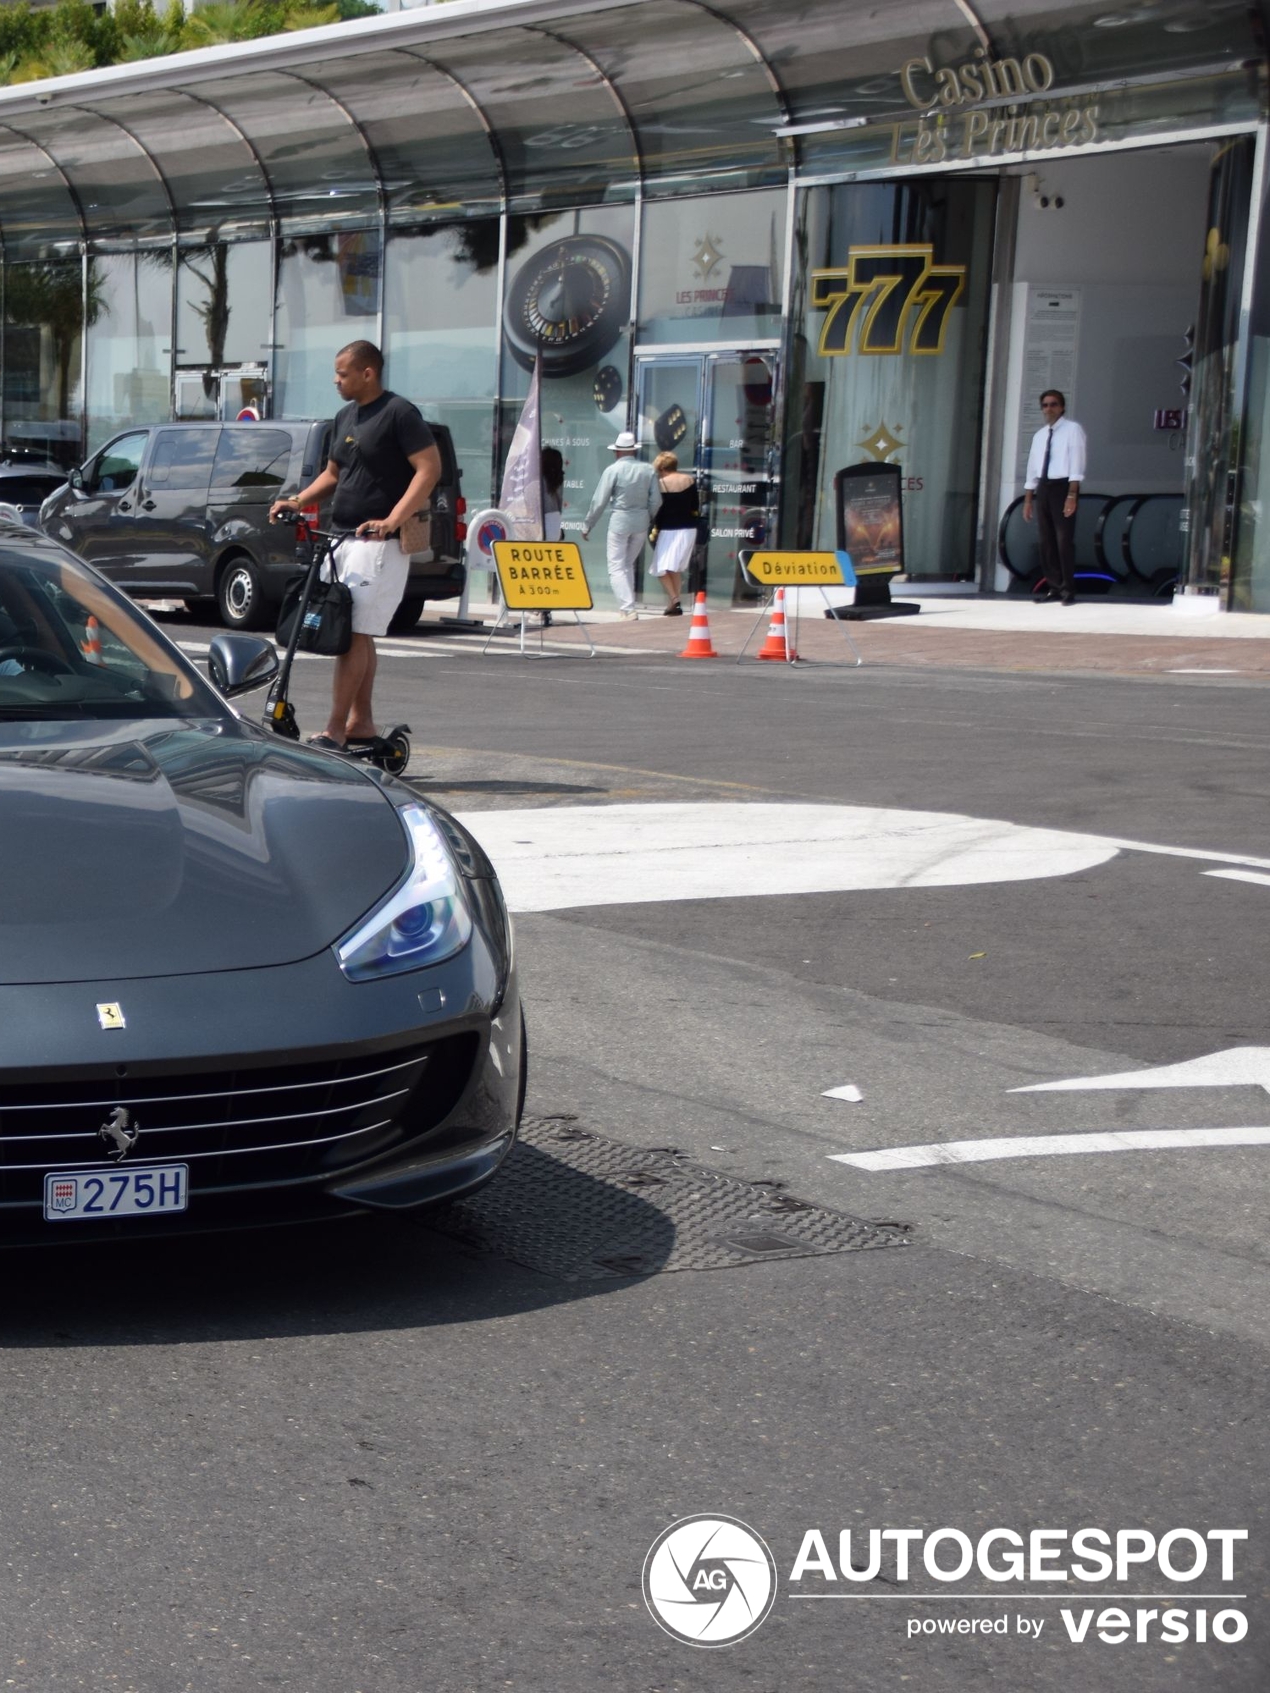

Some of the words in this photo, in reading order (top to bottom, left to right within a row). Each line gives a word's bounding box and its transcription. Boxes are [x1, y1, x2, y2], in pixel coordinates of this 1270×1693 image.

[900, 47, 1054, 110] Casino
[889, 114, 948, 166] Les
[958, 104, 1100, 160] Princes
[676, 291, 692, 305] LES
[811, 243, 966, 357] 777
[572, 438, 590, 447] SOUS
[729, 440, 744, 449] BAR
[563, 480, 584, 489] TABLE
[712, 484, 756, 494] RESTAURANT
[711, 529, 733, 538] SALON
[734, 528, 754, 538] PRIVÉ
[511, 548, 565, 563] ROUTE
[509, 565, 575, 580] BARRÉE
[762, 561, 838, 575] Déviation
[55, 1197, 72, 1208] MC
[83, 1171, 181, 1213] 275H
